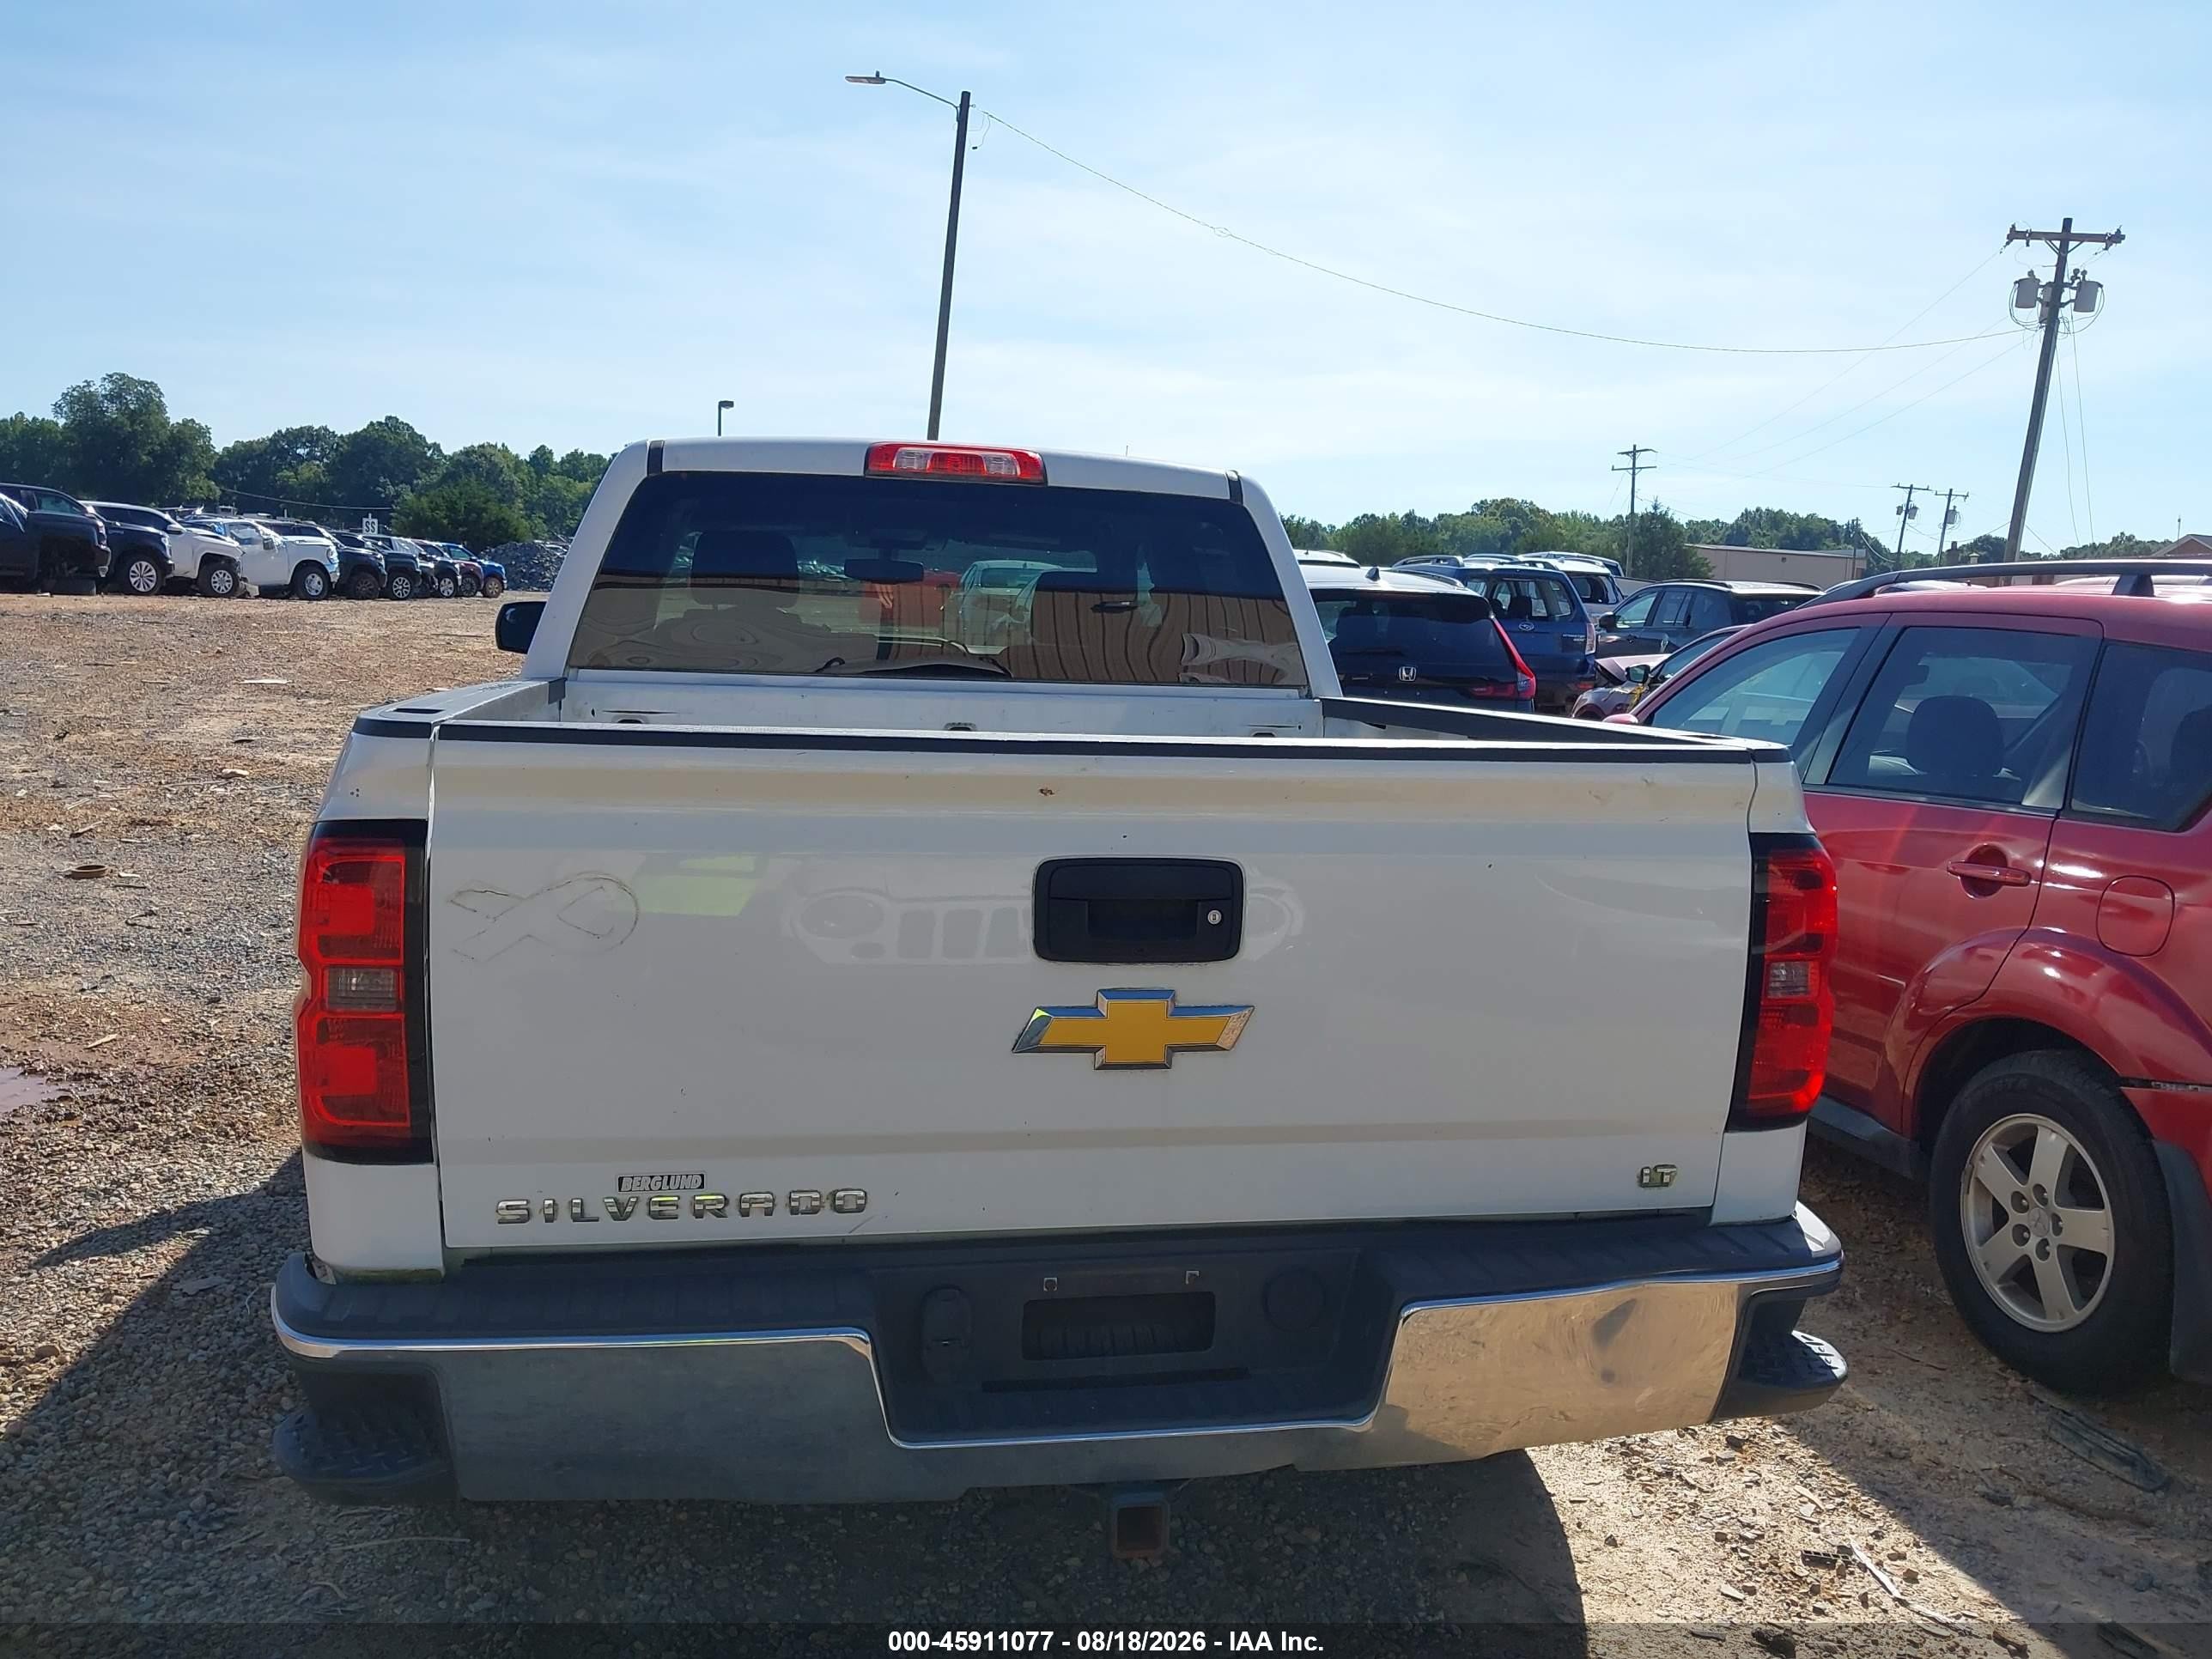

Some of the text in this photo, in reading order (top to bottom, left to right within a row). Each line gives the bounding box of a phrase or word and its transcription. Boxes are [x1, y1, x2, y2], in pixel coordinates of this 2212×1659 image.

[365, 520, 375, 533] SS
[620, 1175, 702, 1192] BERGLUND
[1639, 1164, 1676, 1188] LT
[496, 1188, 867, 1224] SILVERADO
